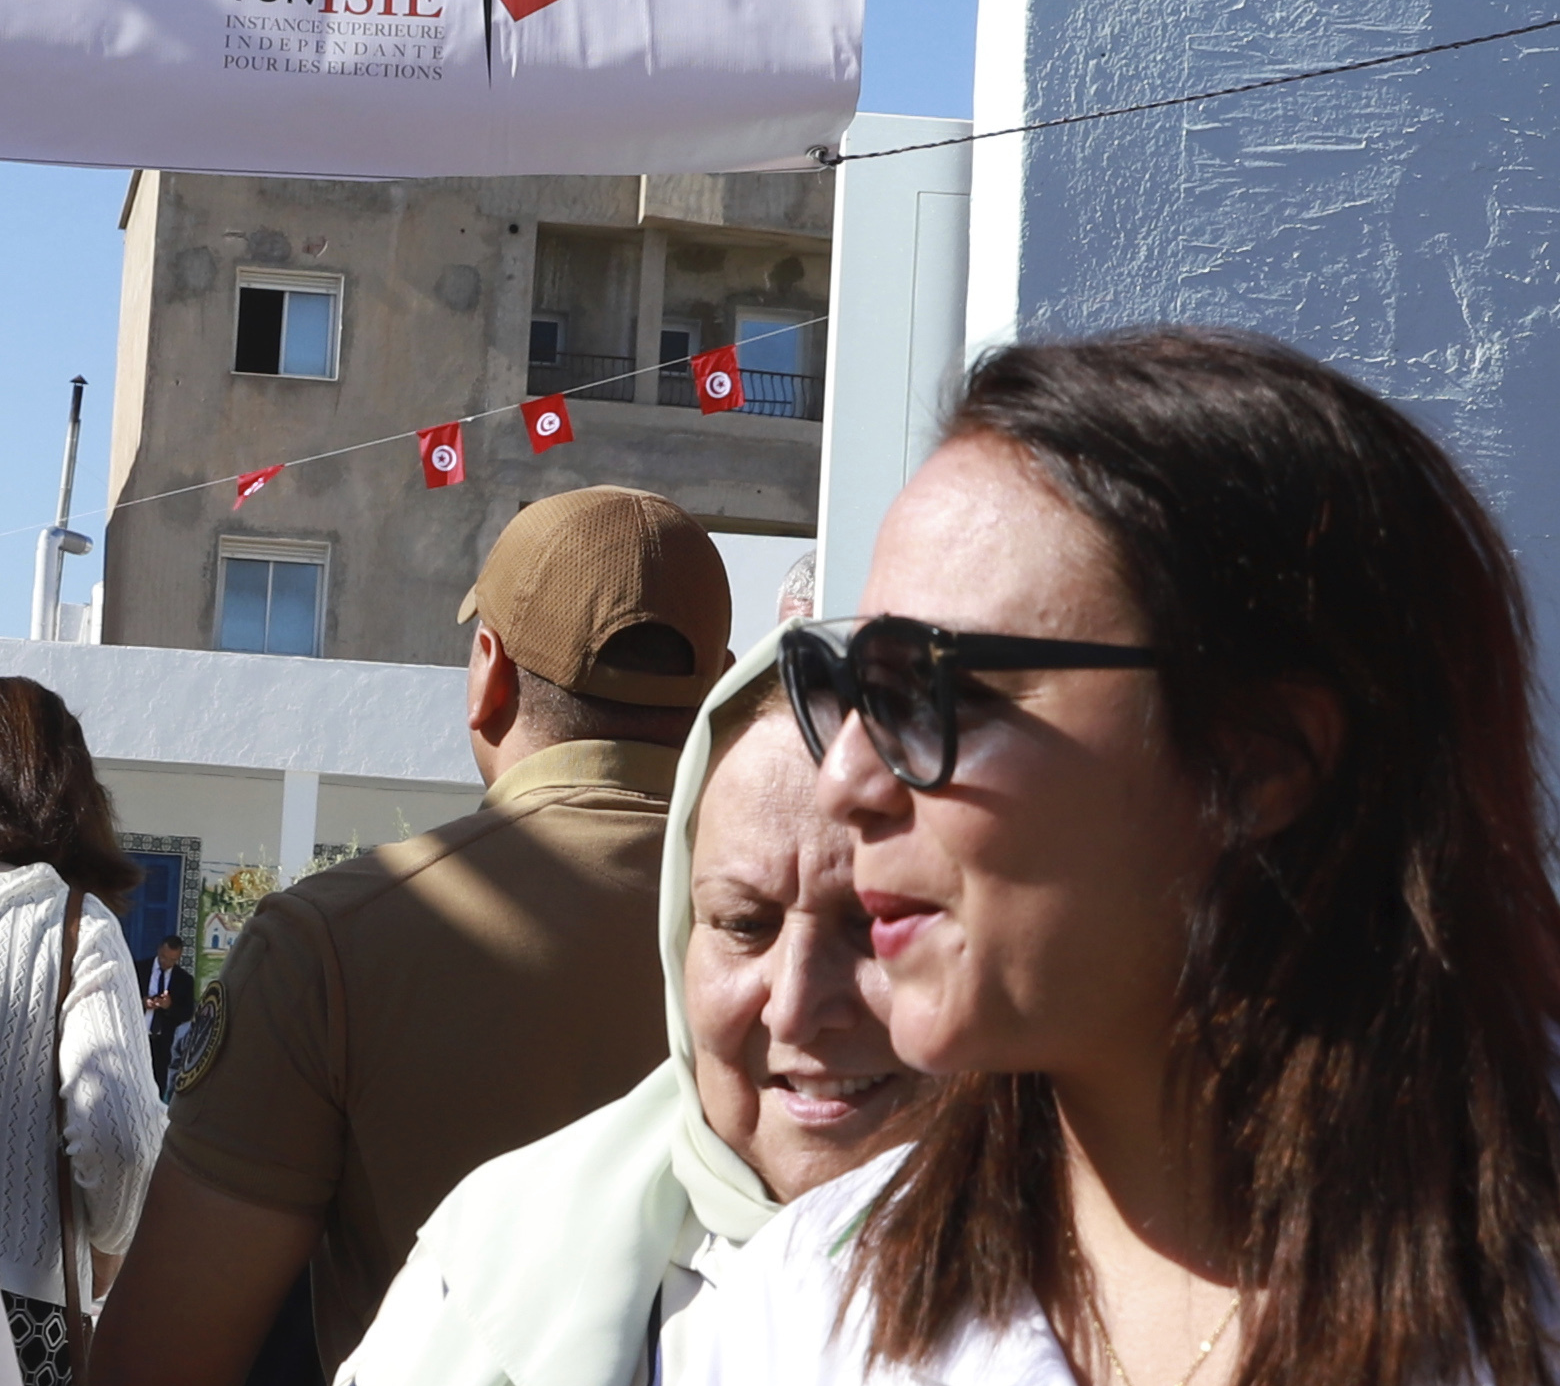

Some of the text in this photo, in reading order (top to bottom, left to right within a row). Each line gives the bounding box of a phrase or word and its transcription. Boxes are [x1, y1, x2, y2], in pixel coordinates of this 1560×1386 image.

[225, 14, 446, 40] INSTANCE SUPERIEURE
[223, 54, 444, 82] POUR LES ELECTIONS
